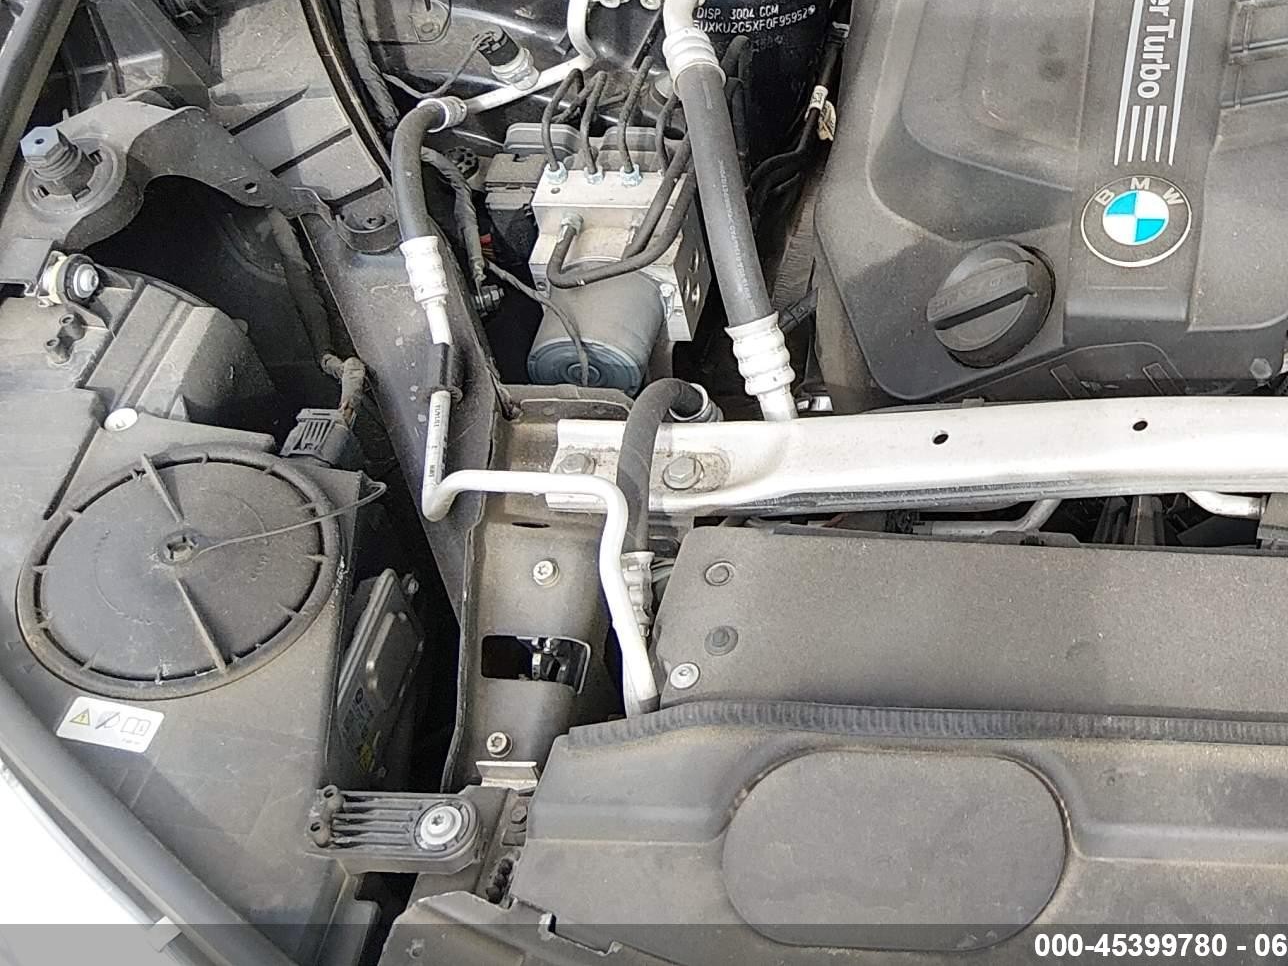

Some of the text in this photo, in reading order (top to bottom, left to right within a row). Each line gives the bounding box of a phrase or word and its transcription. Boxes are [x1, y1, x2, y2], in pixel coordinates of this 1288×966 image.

[696, 3, 780, 20] DISP. 3004 CCM
[1136, 18, 1177, 99] Turbo
[1094, 177, 1186, 208] BMW
